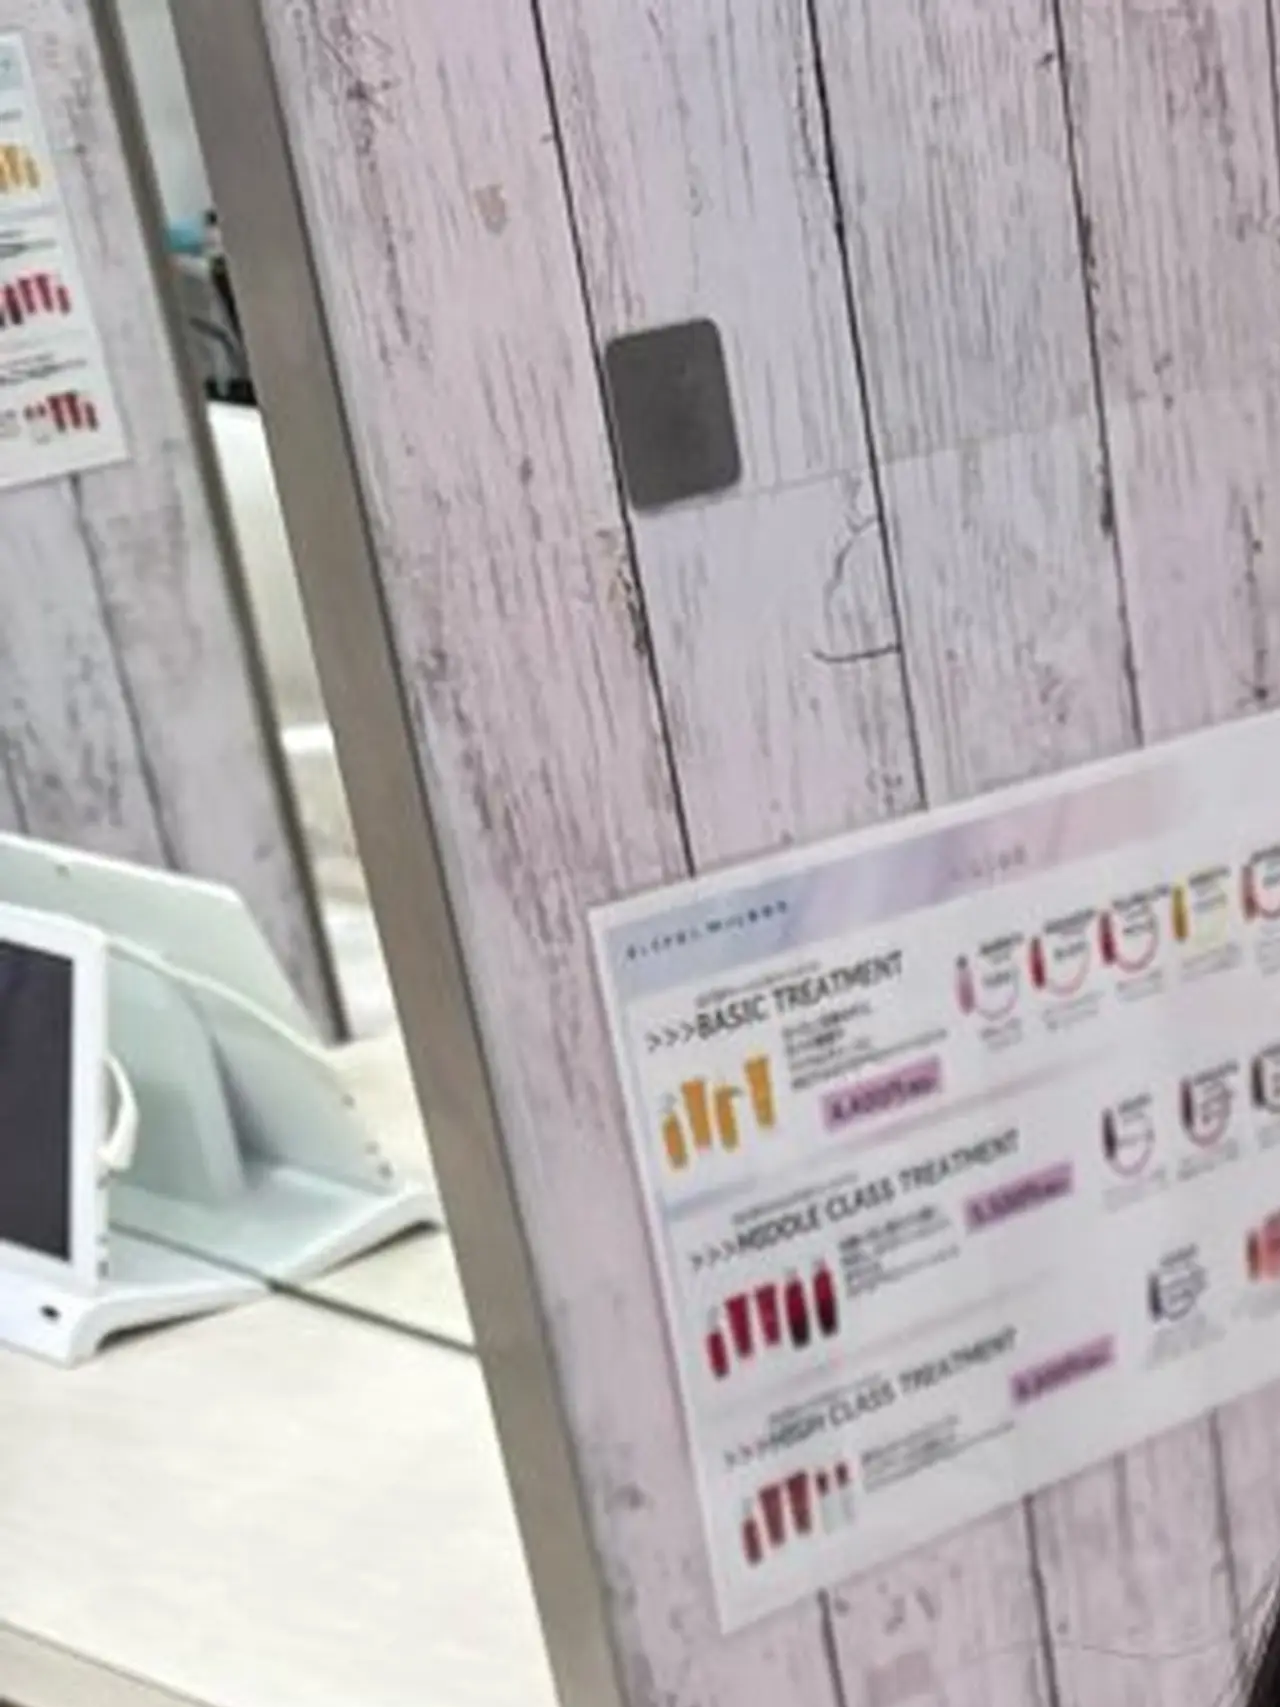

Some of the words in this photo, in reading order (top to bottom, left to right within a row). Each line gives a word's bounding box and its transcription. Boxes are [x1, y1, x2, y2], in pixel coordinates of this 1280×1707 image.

[695, 991, 771, 1041] BASIC
[773, 950, 906, 1021] TREATMENT
[735, 1202, 824, 1258] MIDDLE
[824, 1178, 897, 1238] CLASS
[896, 1128, 1022, 1209] TREATMENT
[824, 1377, 897, 1439] CLASS
[895, 1328, 1020, 1407] TREATMENT
